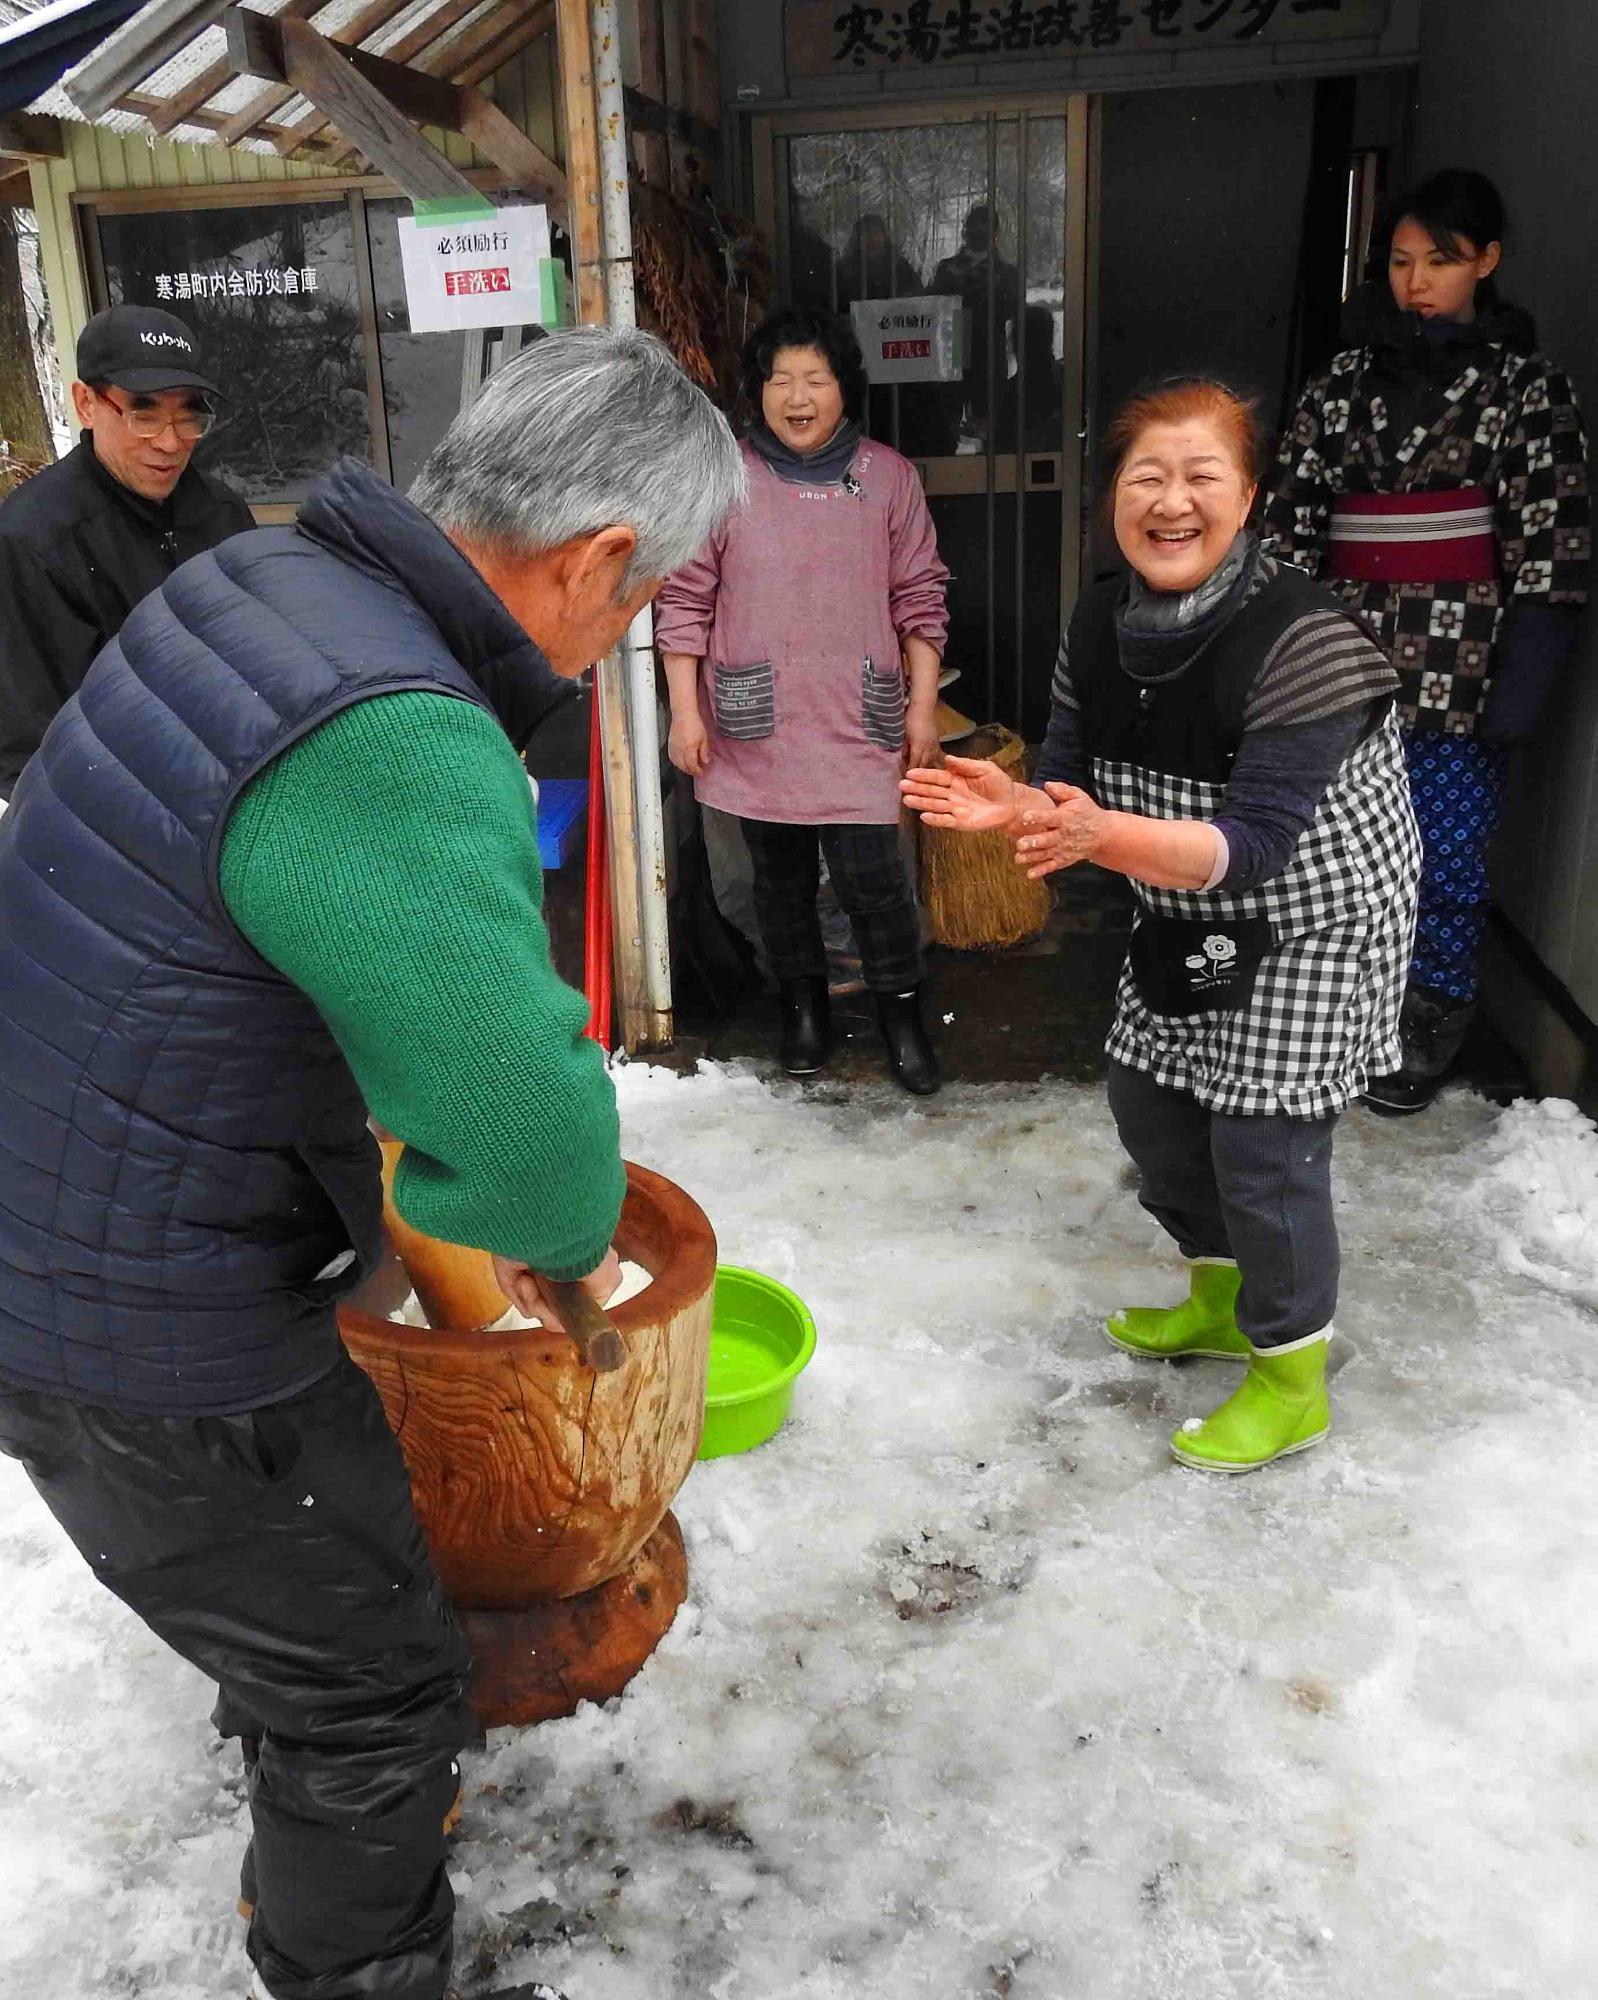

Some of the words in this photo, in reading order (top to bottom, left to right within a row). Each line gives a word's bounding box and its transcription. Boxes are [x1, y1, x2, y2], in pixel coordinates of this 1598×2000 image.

[437, 231, 508, 255] 必須励行
[155, 266, 319, 301] 寒湯町内会防災倉庫
[446, 269, 510, 295] 手洗い
